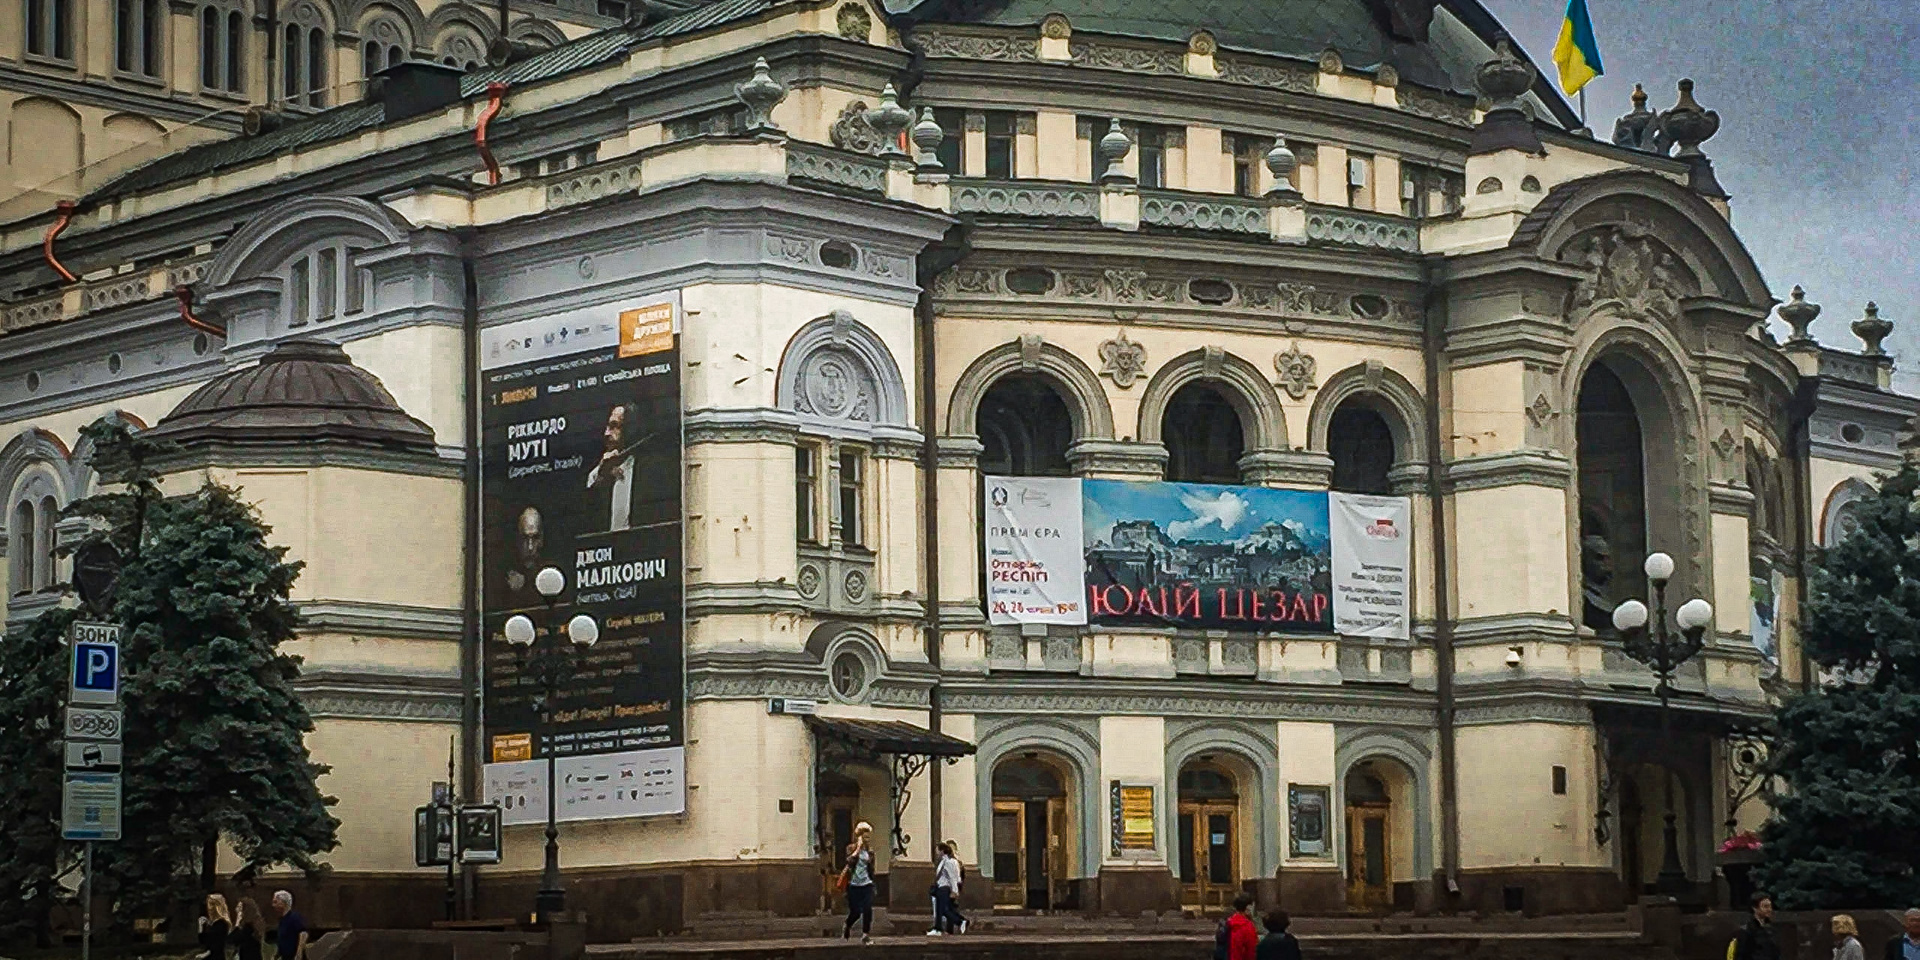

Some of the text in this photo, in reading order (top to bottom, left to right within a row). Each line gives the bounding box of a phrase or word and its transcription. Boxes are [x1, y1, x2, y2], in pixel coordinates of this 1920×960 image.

[508, 416, 566, 439] РІККАРДО
[508, 438, 548, 462] МУТІ
[576, 547, 613, 568] ДЖОН
[577, 558, 665, 589] МАЛКОВИЧ
[1089, 582, 1328, 622] ЮЛІЙ ЦЕЗАР
[75, 626, 119, 642] ЗОНА
[86, 648, 109, 686] P
